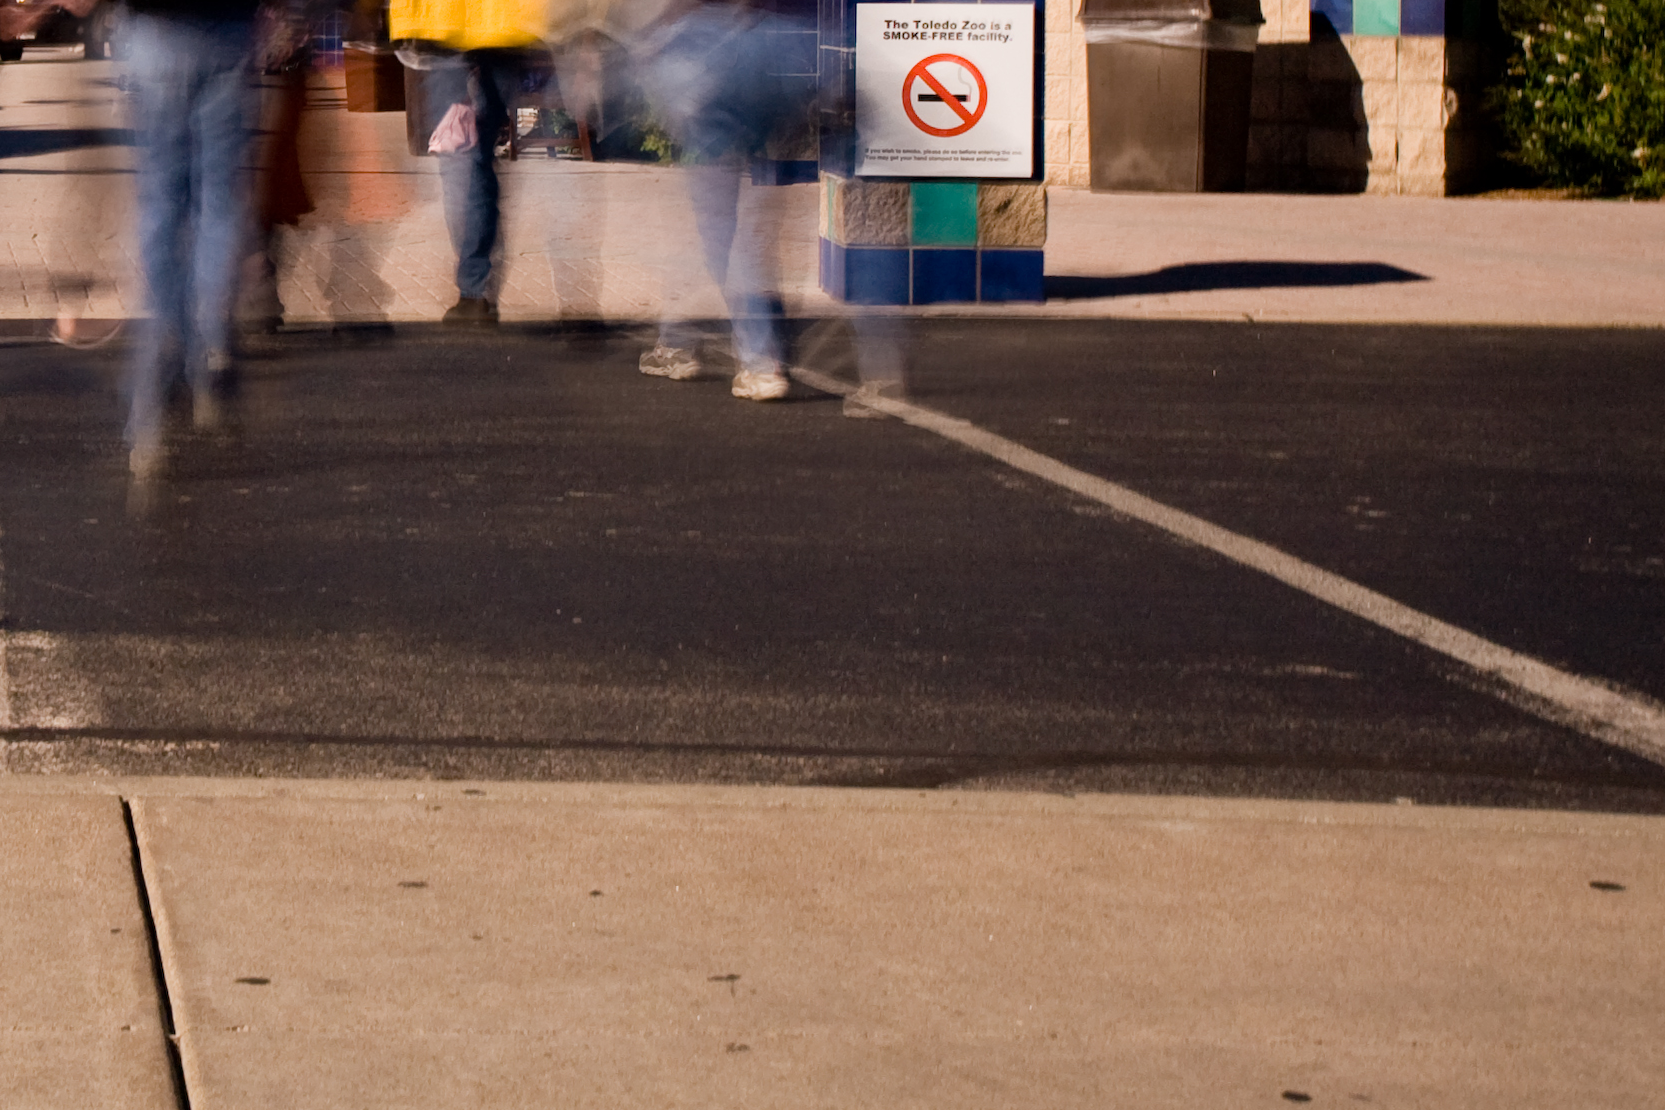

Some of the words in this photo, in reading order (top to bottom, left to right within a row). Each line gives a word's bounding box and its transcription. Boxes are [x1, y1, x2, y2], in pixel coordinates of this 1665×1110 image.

[884, 20, 909, 30] The
[913, 20, 957, 30] Toledo
[962, 21, 986, 30] Zoo
[990, 21, 1000, 31] is
[1004, 22, 1012, 31] a
[883, 31, 963, 41] SMOKE-FREE
[967, 32, 1013, 43] facility.
